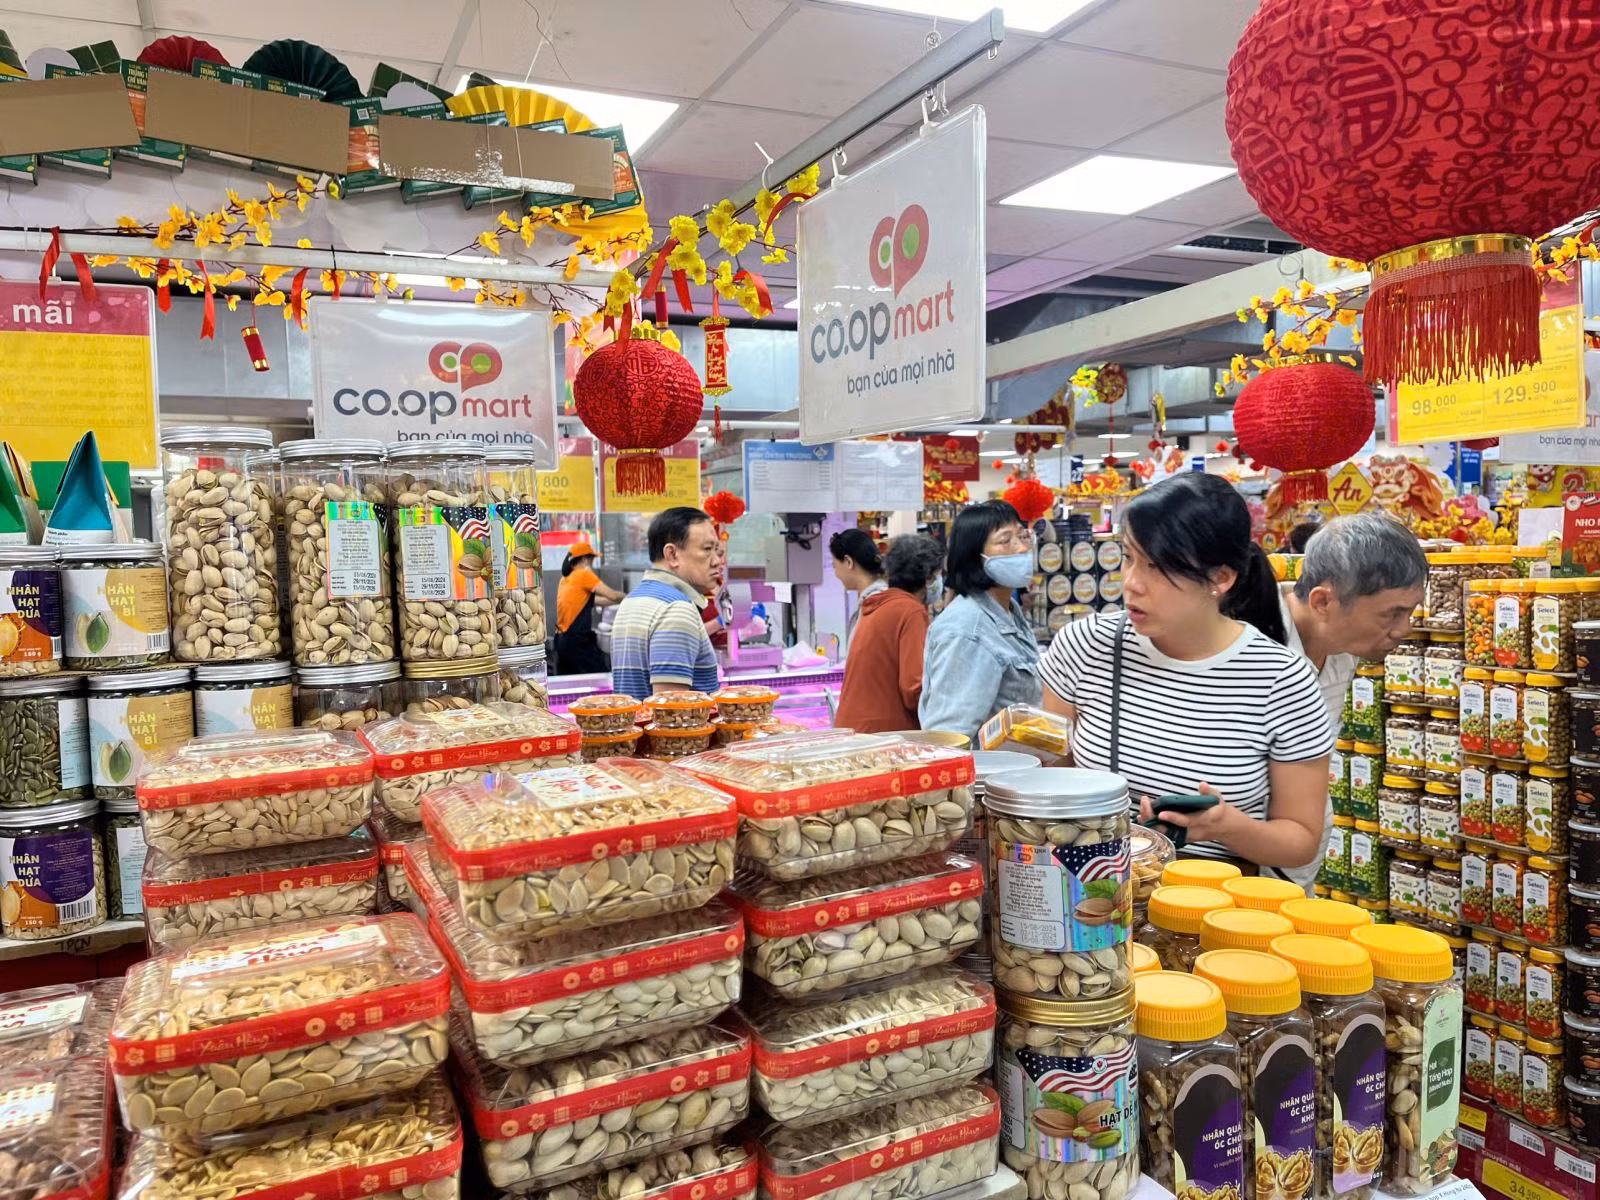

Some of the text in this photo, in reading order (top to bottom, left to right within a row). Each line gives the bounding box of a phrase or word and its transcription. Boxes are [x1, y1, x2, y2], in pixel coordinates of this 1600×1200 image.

[13, 300, 73, 325] mãi
[894, 280, 955, 339] mart
[847, 349, 955, 397] bạn của mọi nhà
[462, 394, 532, 418] mart
[471, 430, 499, 446] mọi
[504, 431, 533, 443] nhà
[7, 584, 39, 595] NHÂN
[10, 853, 40, 864] NHÂN
[1356, 1075, 1374, 1086] NHÂN
[1280, 1097, 1300, 1109] NHÂN
[1100, 1112, 1121, 1127] HẠT
[1202, 1129, 1225, 1143] NHÂN
